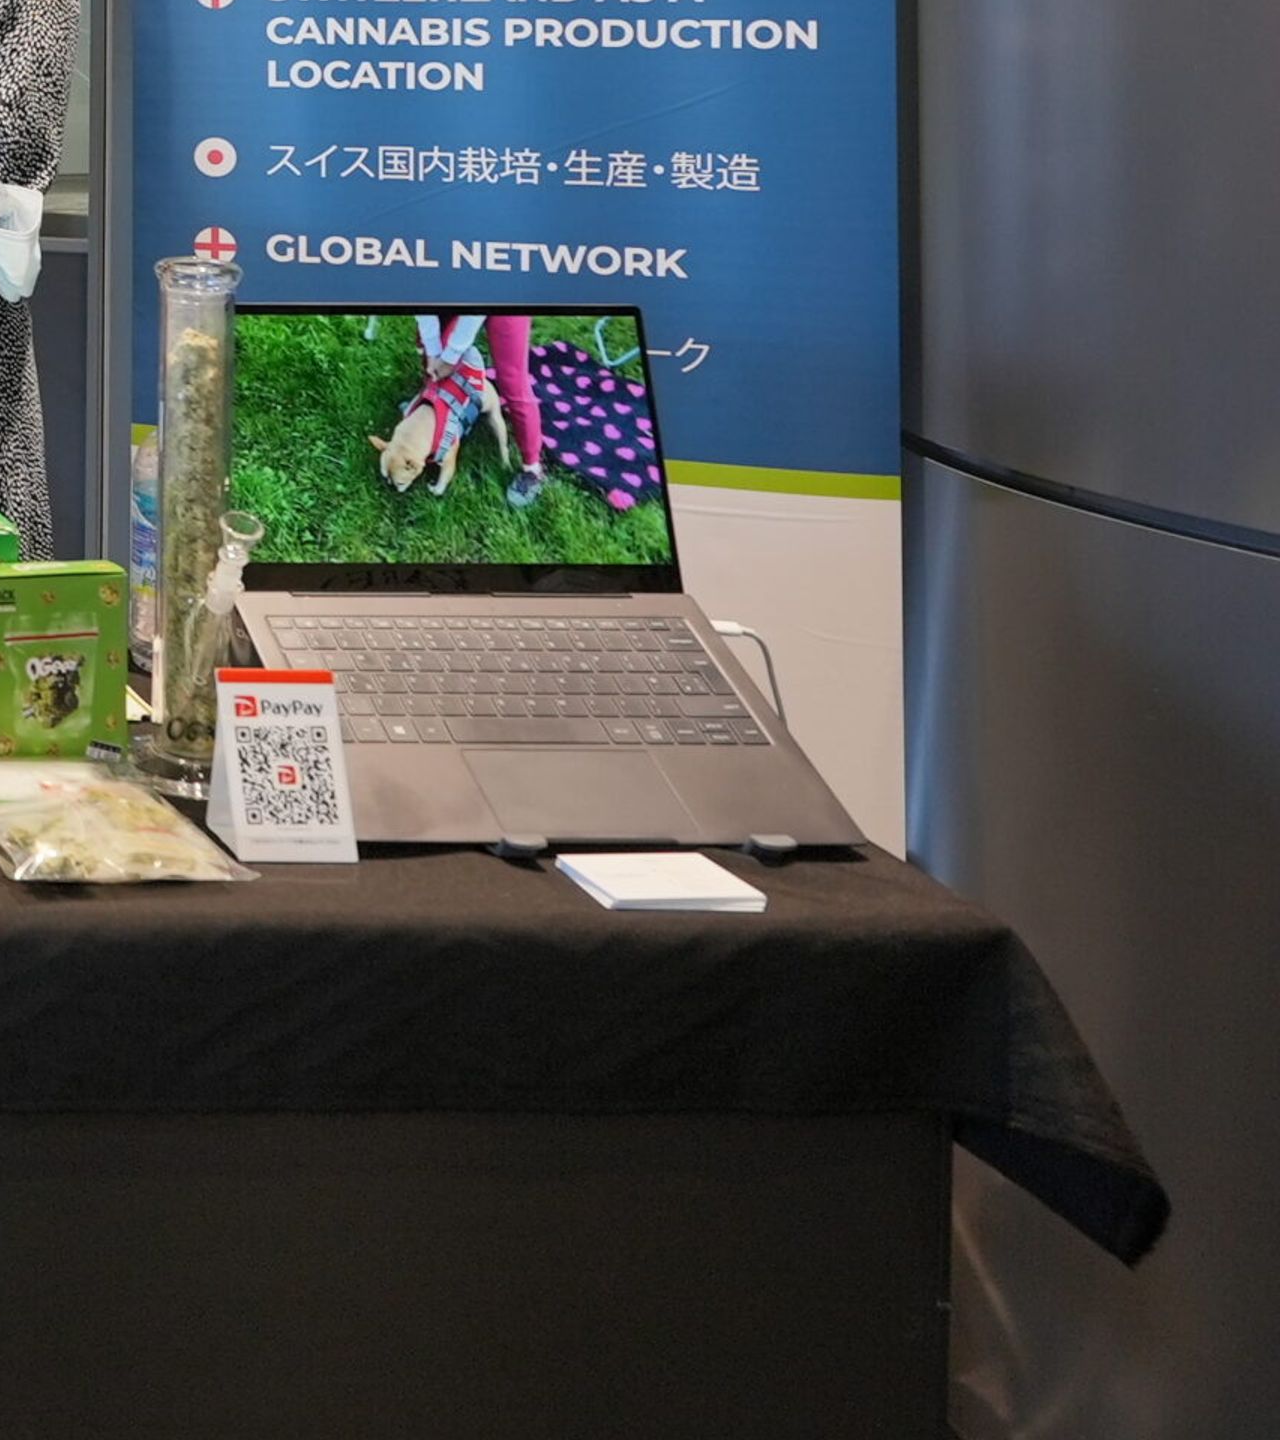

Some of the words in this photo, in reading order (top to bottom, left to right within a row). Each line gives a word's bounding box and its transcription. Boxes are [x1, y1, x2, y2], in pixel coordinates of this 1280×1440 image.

[265, 16, 491, 47] CANNABIS
[503, 18, 818, 50] PRODUCTION
[265, 60, 485, 91] LOCATION
[266, 143, 761, 194] スイス国内栽培・生産・製造
[265, 233, 439, 268] GLOBAL
[451, 239, 689, 279] NETWORK
[261, 699, 323, 717] PayPay
